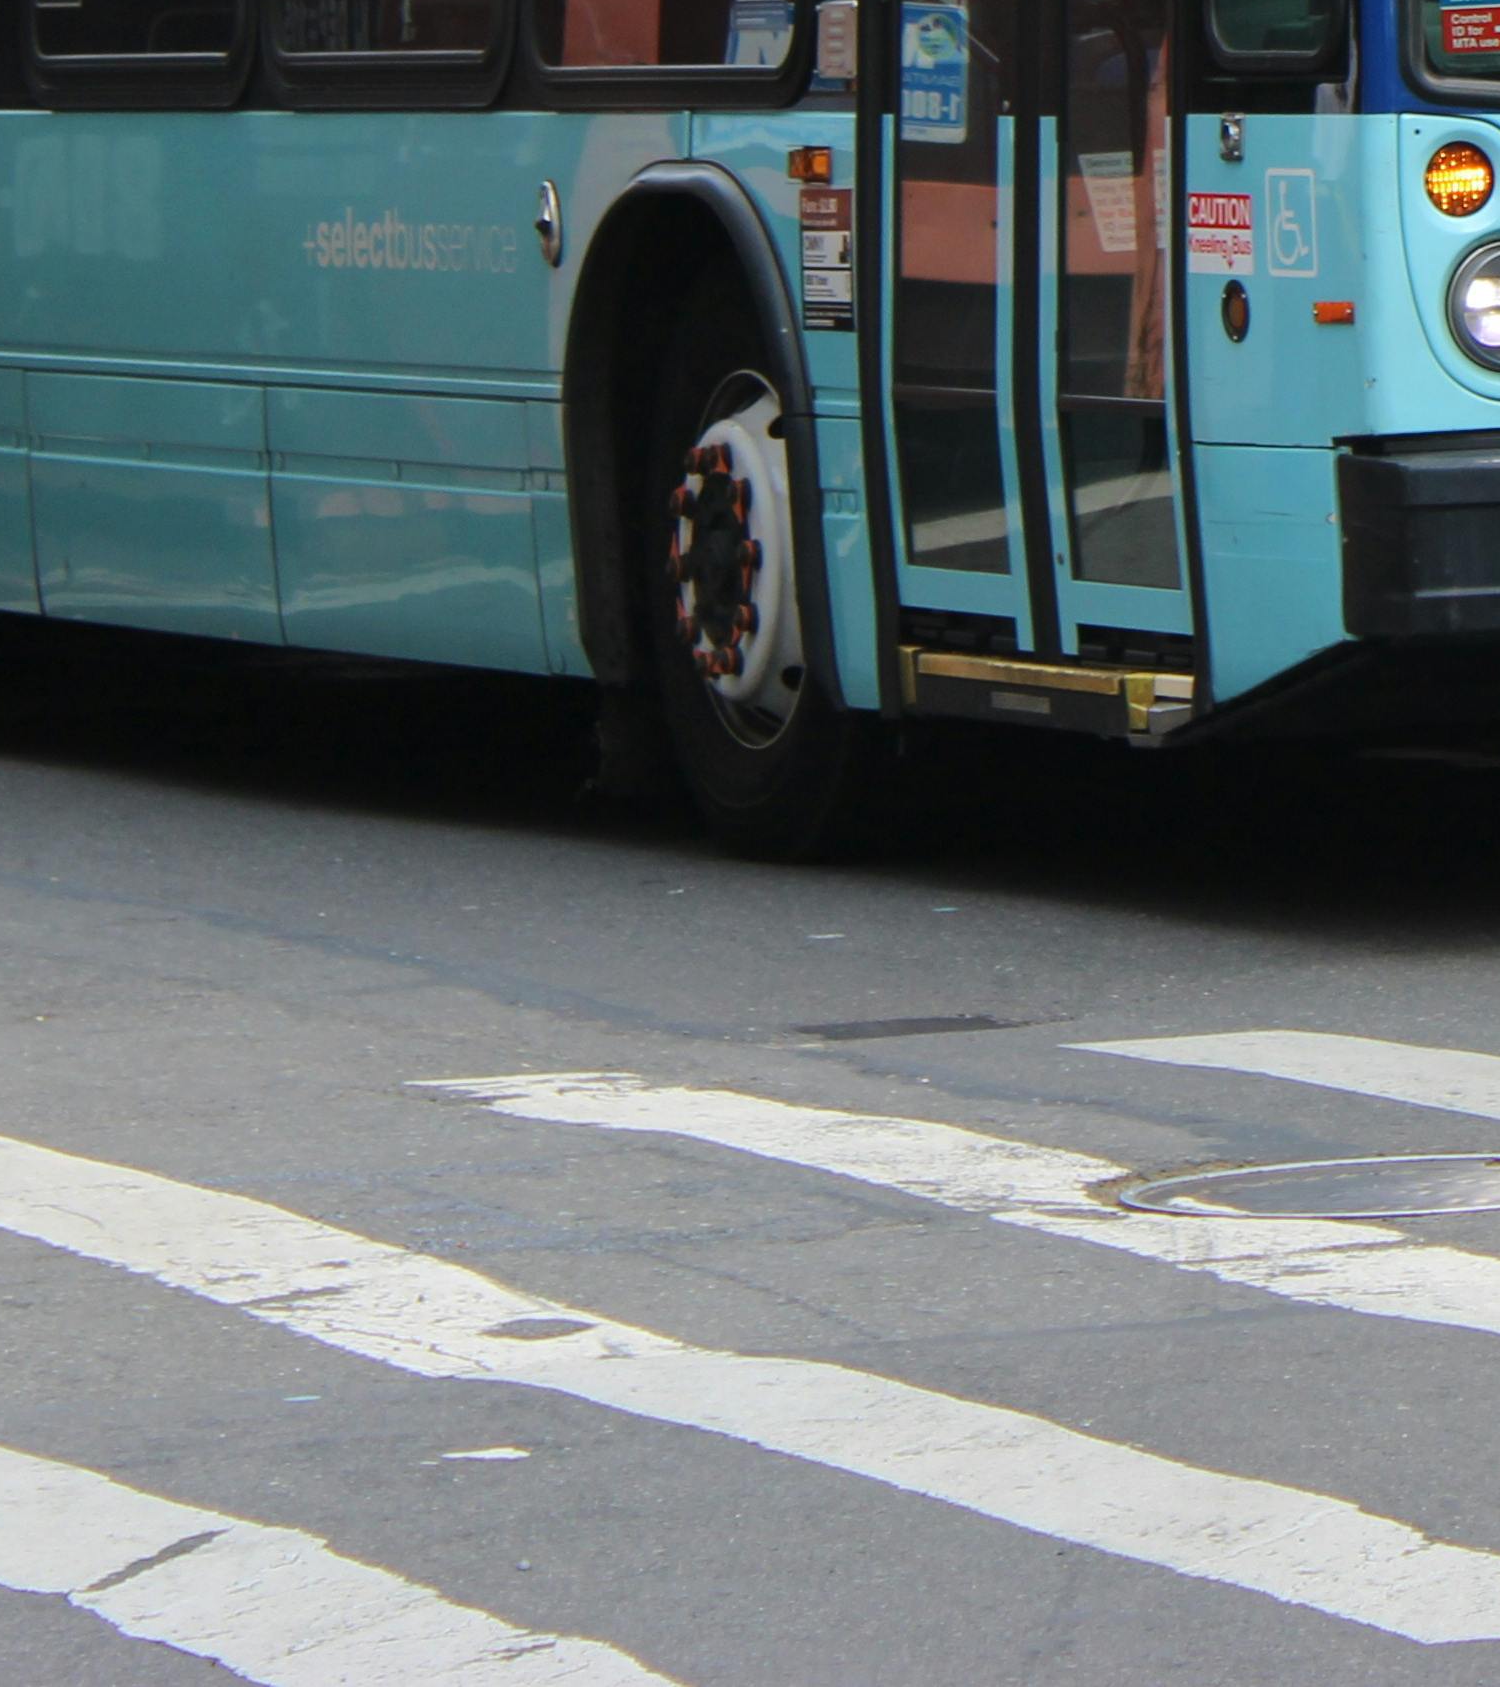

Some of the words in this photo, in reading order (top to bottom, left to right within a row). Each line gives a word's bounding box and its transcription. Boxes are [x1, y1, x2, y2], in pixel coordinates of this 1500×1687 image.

[1451, 12, 1493, 25] Control
[1452, 26, 1466, 37] ID
[1467, 26, 1485, 36] for
[1453, 38, 1478, 49] MTA
[1479, 38, 1500, 48] use
[1188, 196, 1251, 227] CAUTION
